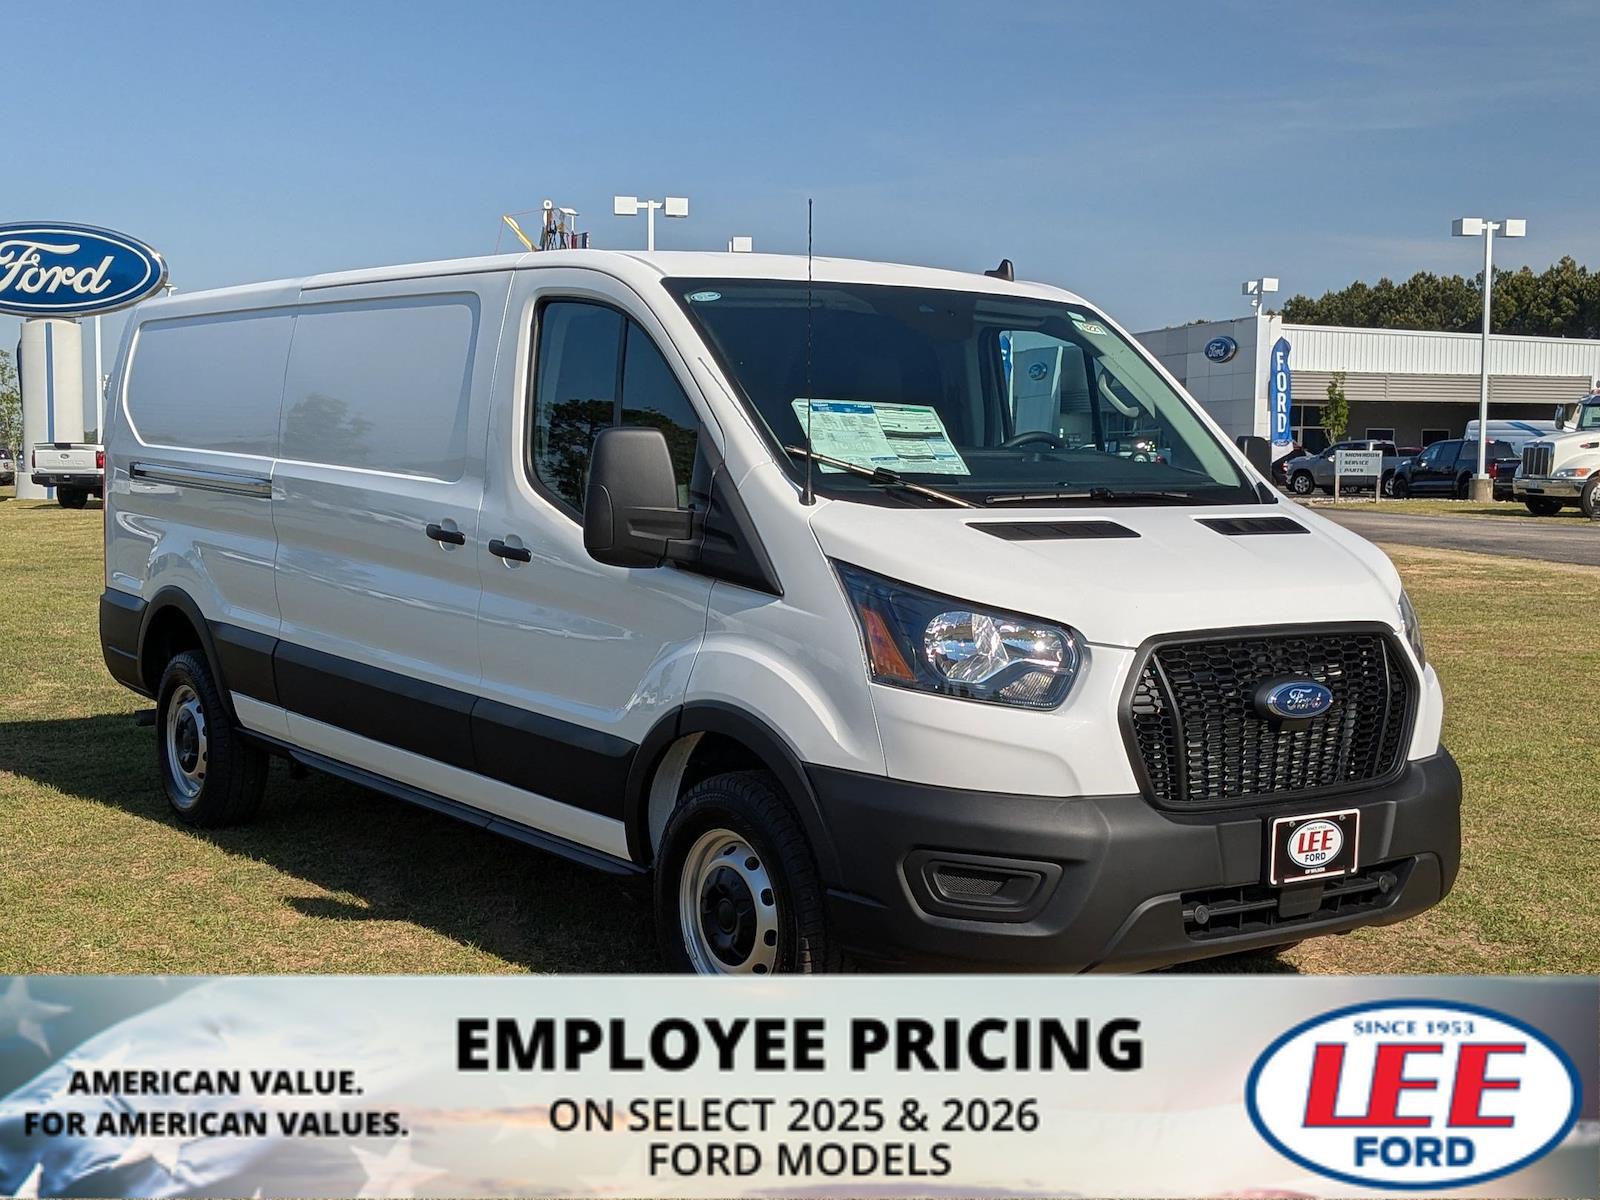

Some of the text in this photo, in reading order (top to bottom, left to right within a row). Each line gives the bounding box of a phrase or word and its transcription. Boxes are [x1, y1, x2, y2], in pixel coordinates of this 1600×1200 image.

[0, 240, 115, 294] Ford
[1207, 343, 1225, 357] Ford
[1276, 351, 1288, 433] FORD
[1286, 688, 1322, 710] Ford
[1297, 829, 1334, 855] LEE
[1304, 852, 1326, 863] FORD
